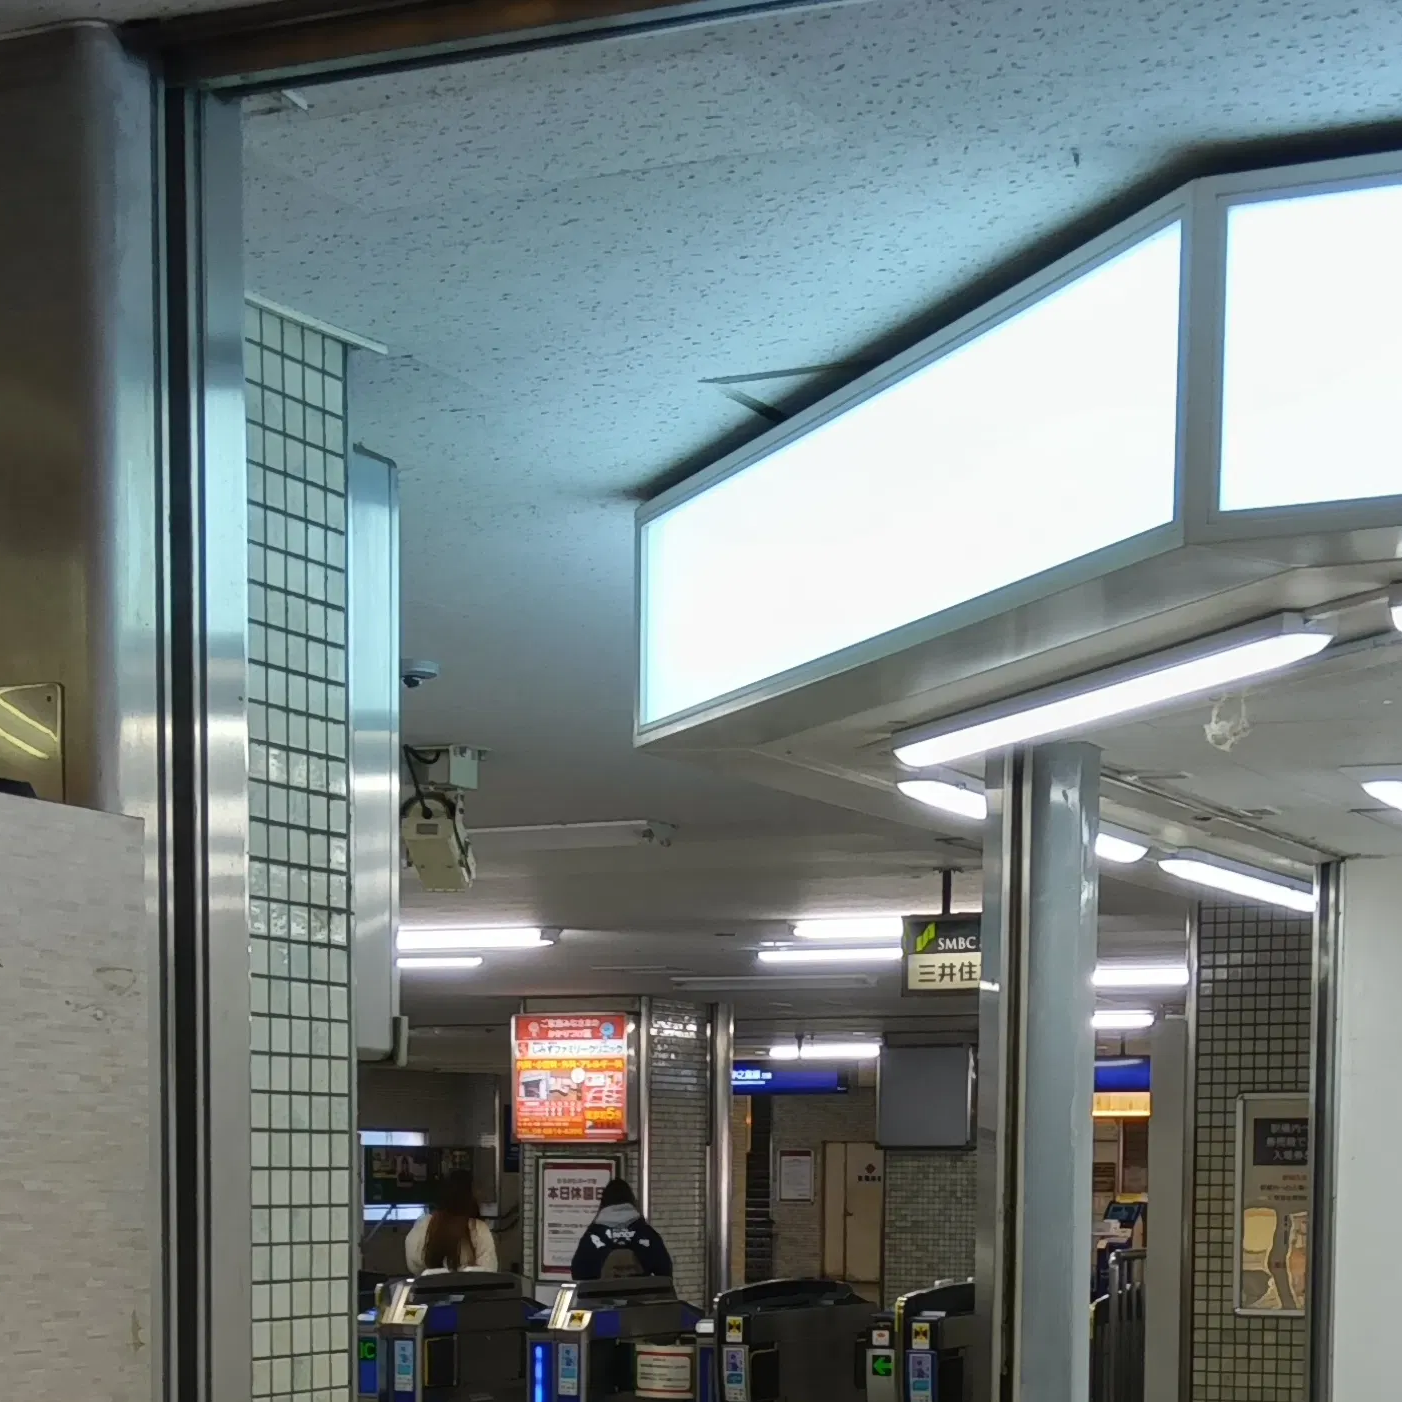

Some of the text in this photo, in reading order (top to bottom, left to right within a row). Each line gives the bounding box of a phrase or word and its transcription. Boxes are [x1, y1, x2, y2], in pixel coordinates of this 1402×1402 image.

[937, 936, 977, 950] SMBC
[917, 961, 981, 983] 三井住
